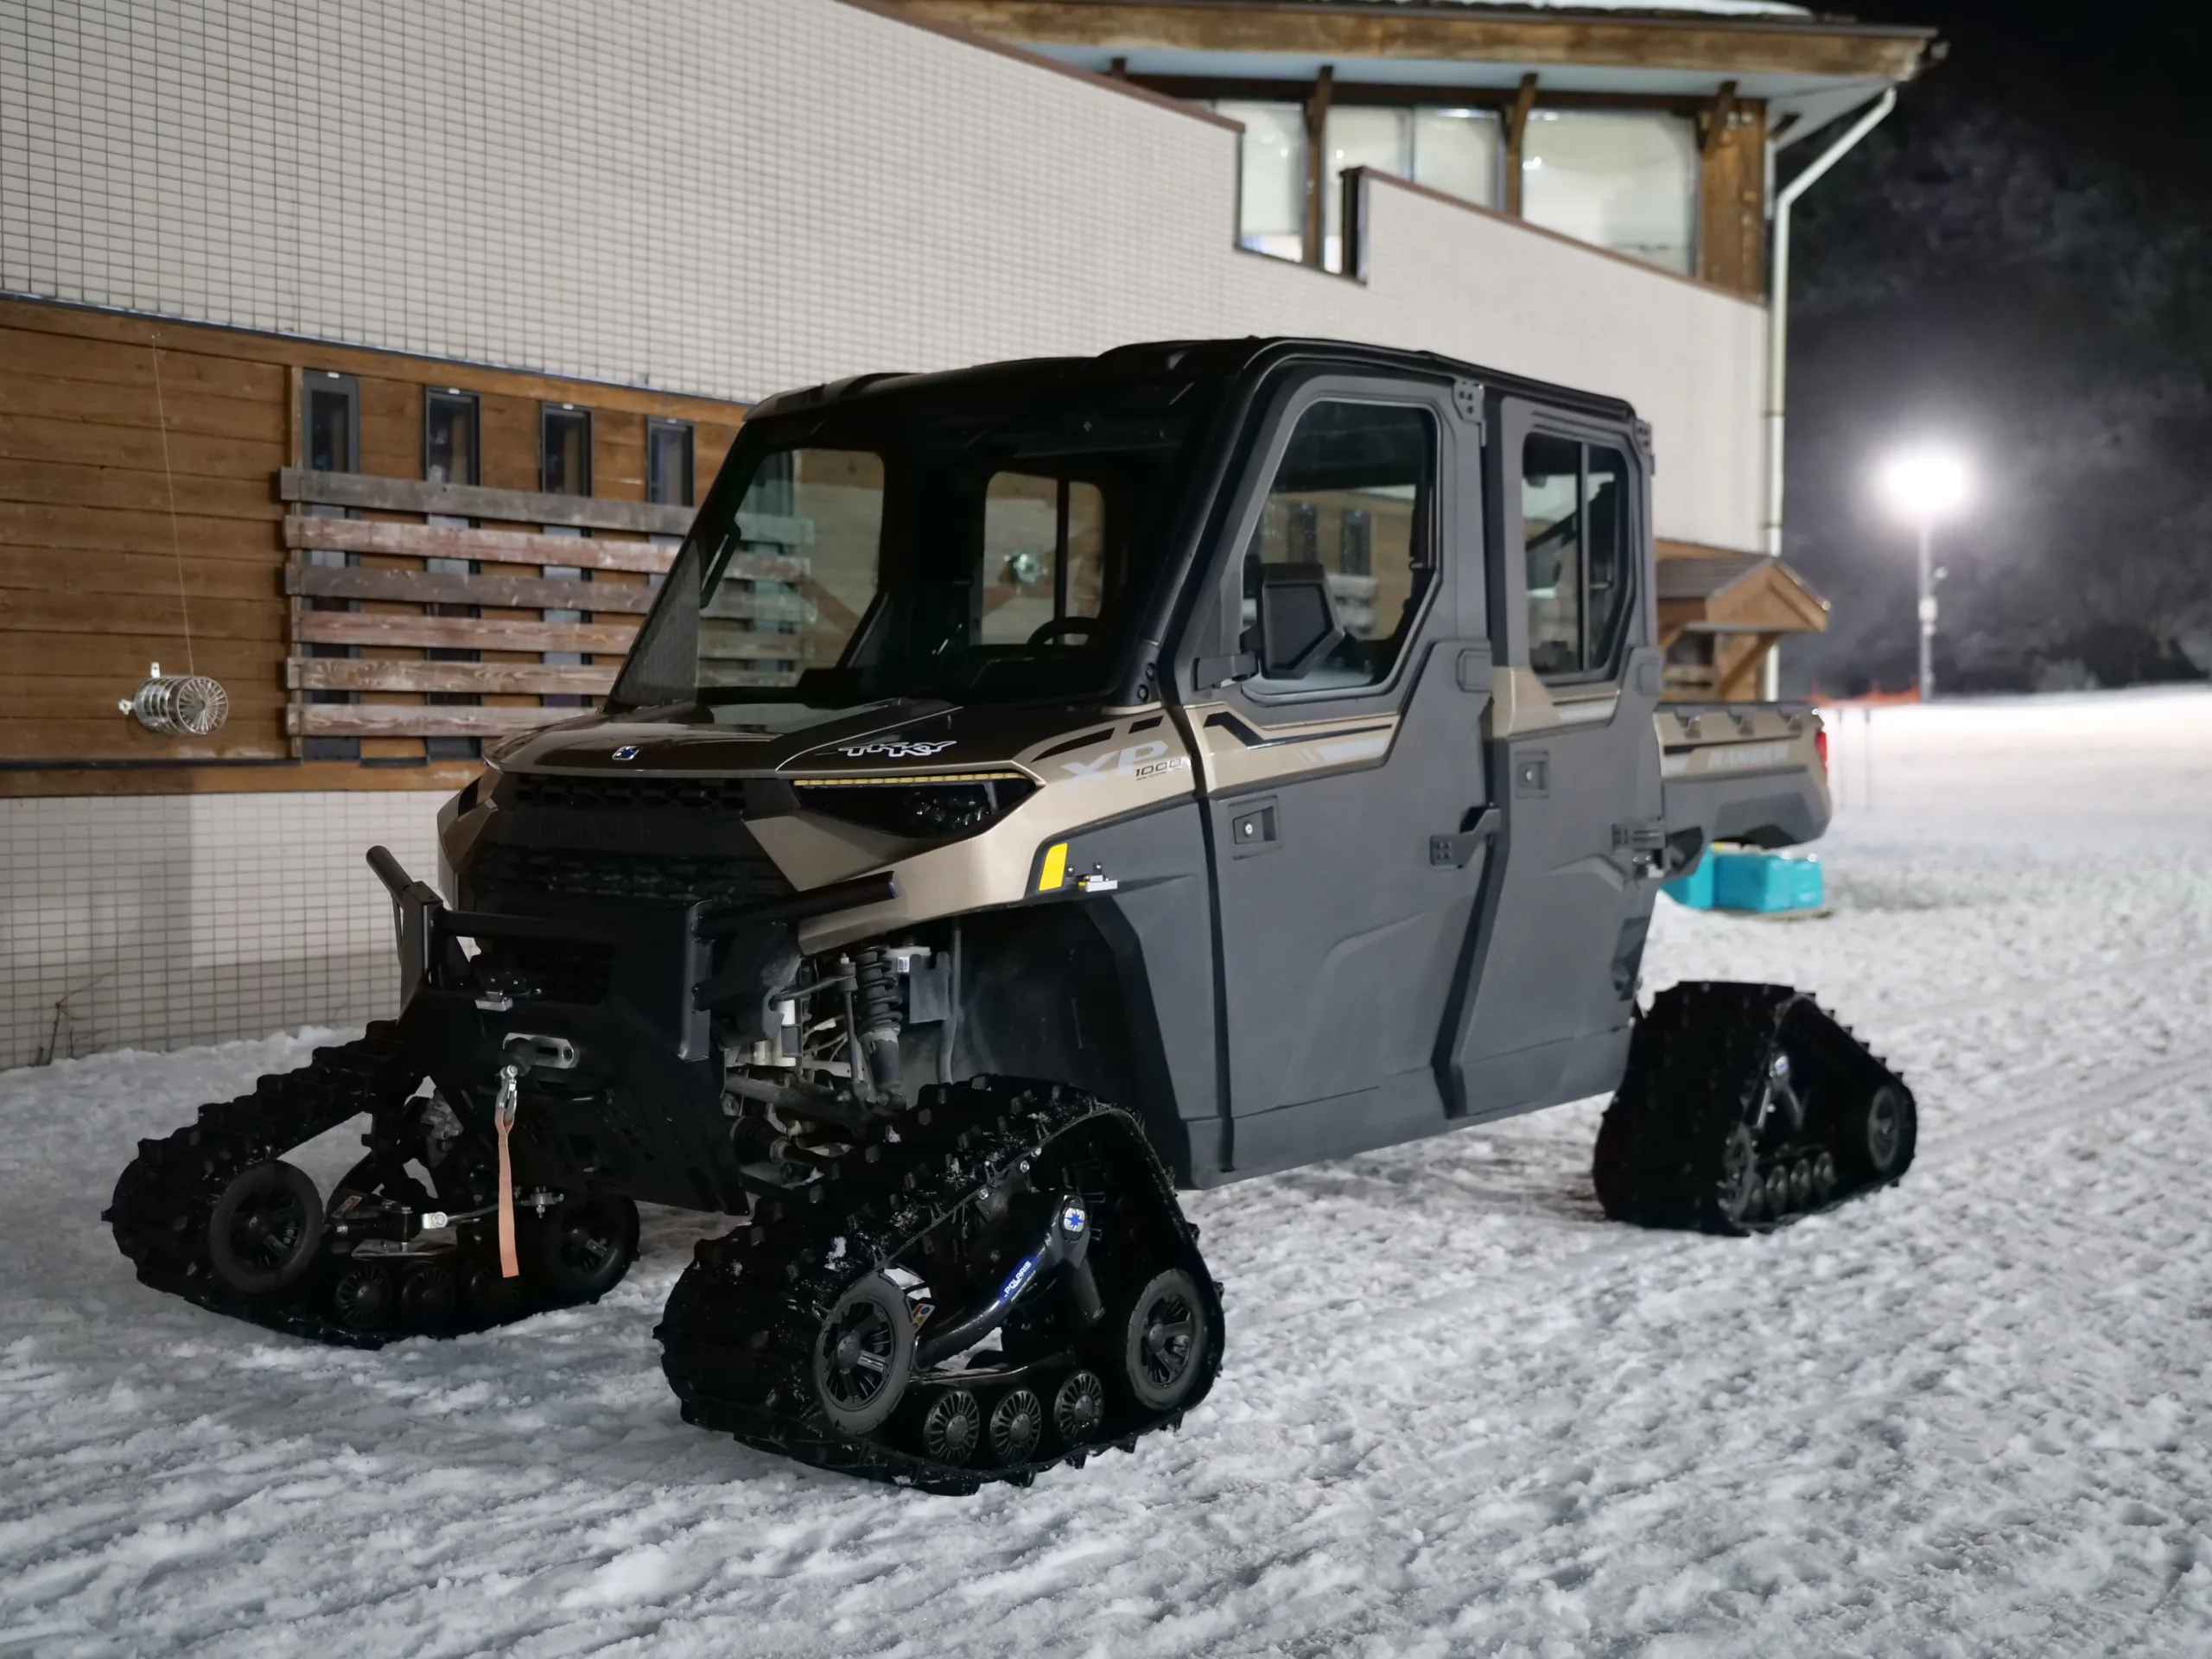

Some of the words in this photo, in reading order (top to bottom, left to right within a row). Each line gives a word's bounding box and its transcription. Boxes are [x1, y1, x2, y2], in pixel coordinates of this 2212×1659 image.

[1055, 740, 1169, 794] XP
[1135, 760, 1181, 778] 1000
[1004, 1261, 1032, 1294] POLARIS
